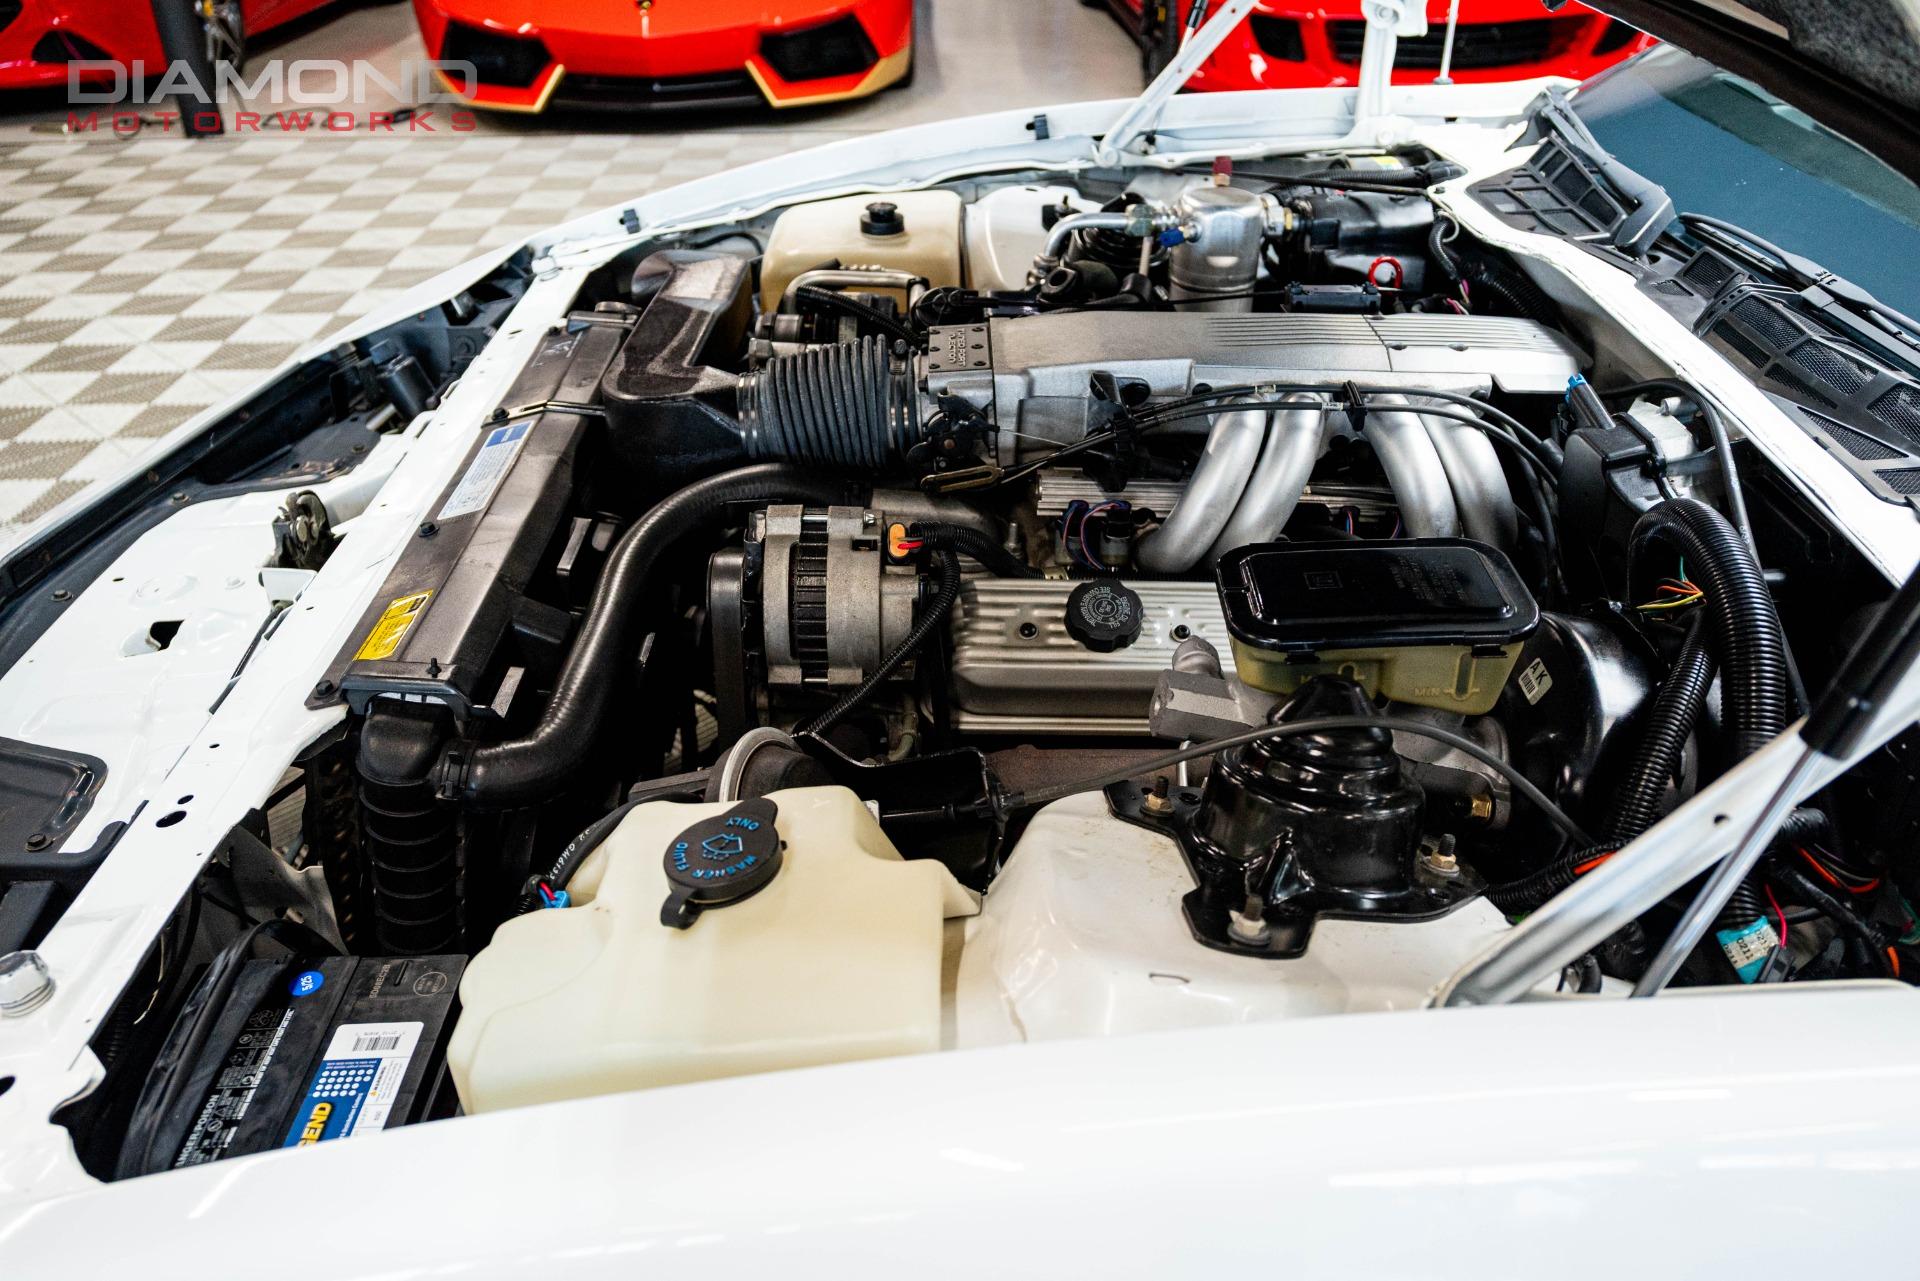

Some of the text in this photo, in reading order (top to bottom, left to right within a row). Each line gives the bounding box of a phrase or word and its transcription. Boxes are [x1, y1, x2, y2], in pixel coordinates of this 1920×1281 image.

[726, 816, 760, 830] ONLY
[672, 840, 758, 879] WASHER FLUID
